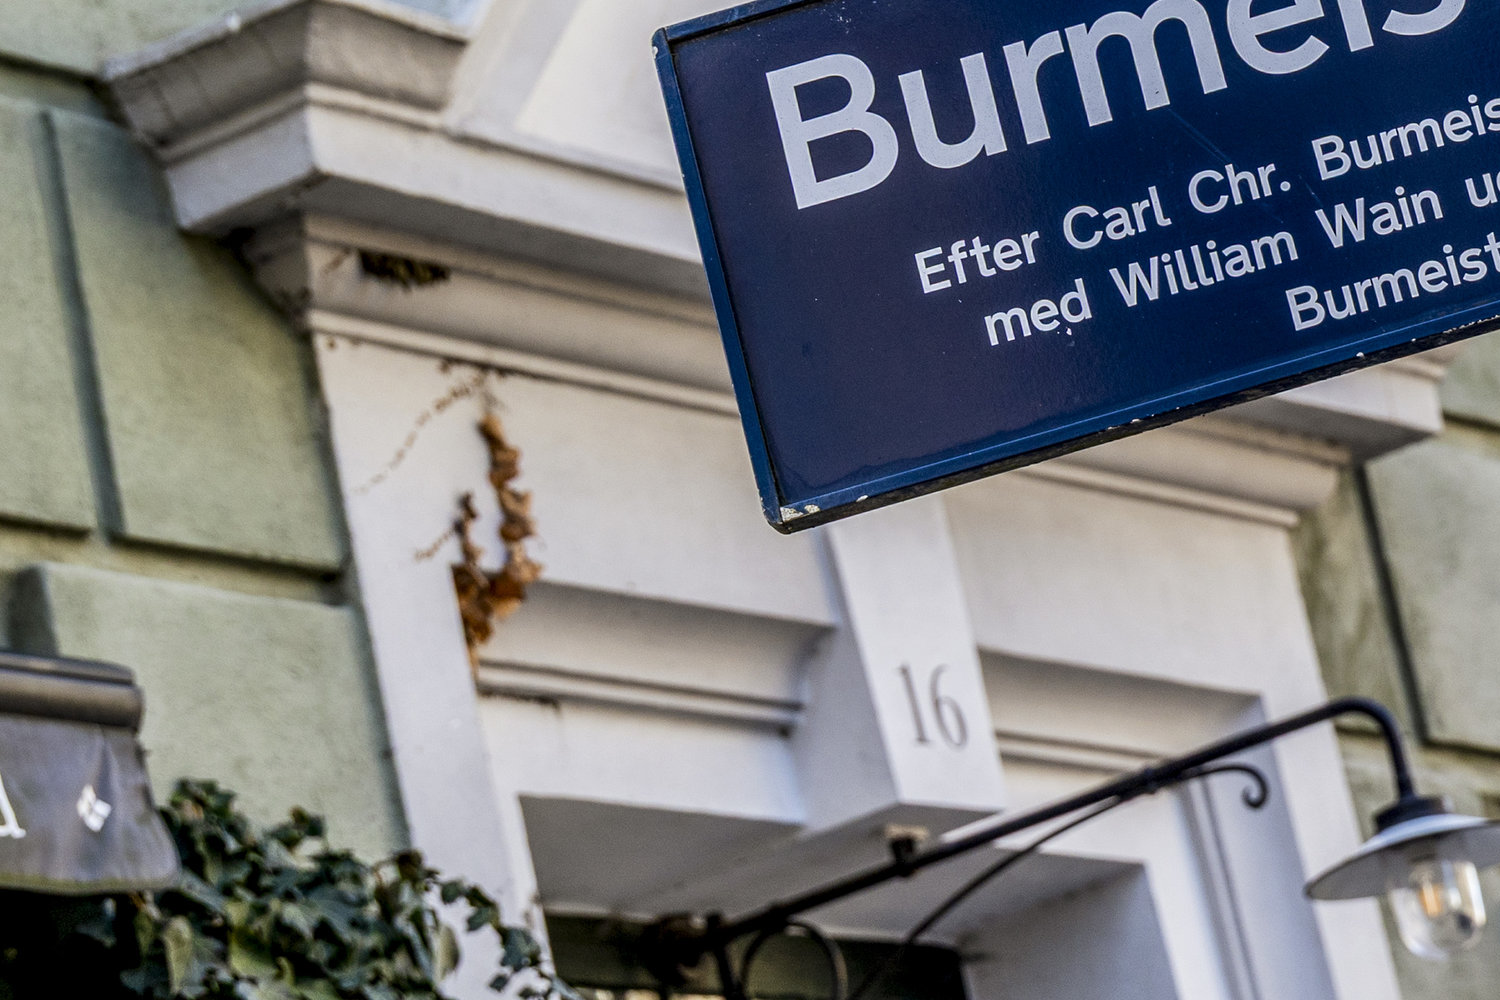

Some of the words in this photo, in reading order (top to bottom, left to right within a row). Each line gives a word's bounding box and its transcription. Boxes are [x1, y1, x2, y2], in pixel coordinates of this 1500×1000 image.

[915, 231, 1039, 293] Efter
[1064, 186, 1171, 249] Carl
[1189, 164, 1290, 213] Chr.
[984, 278, 1092, 346] med
[1109, 232, 1298, 307] William
[1315, 186, 1443, 248] Wain
[898, 662, 968, 748] 16
